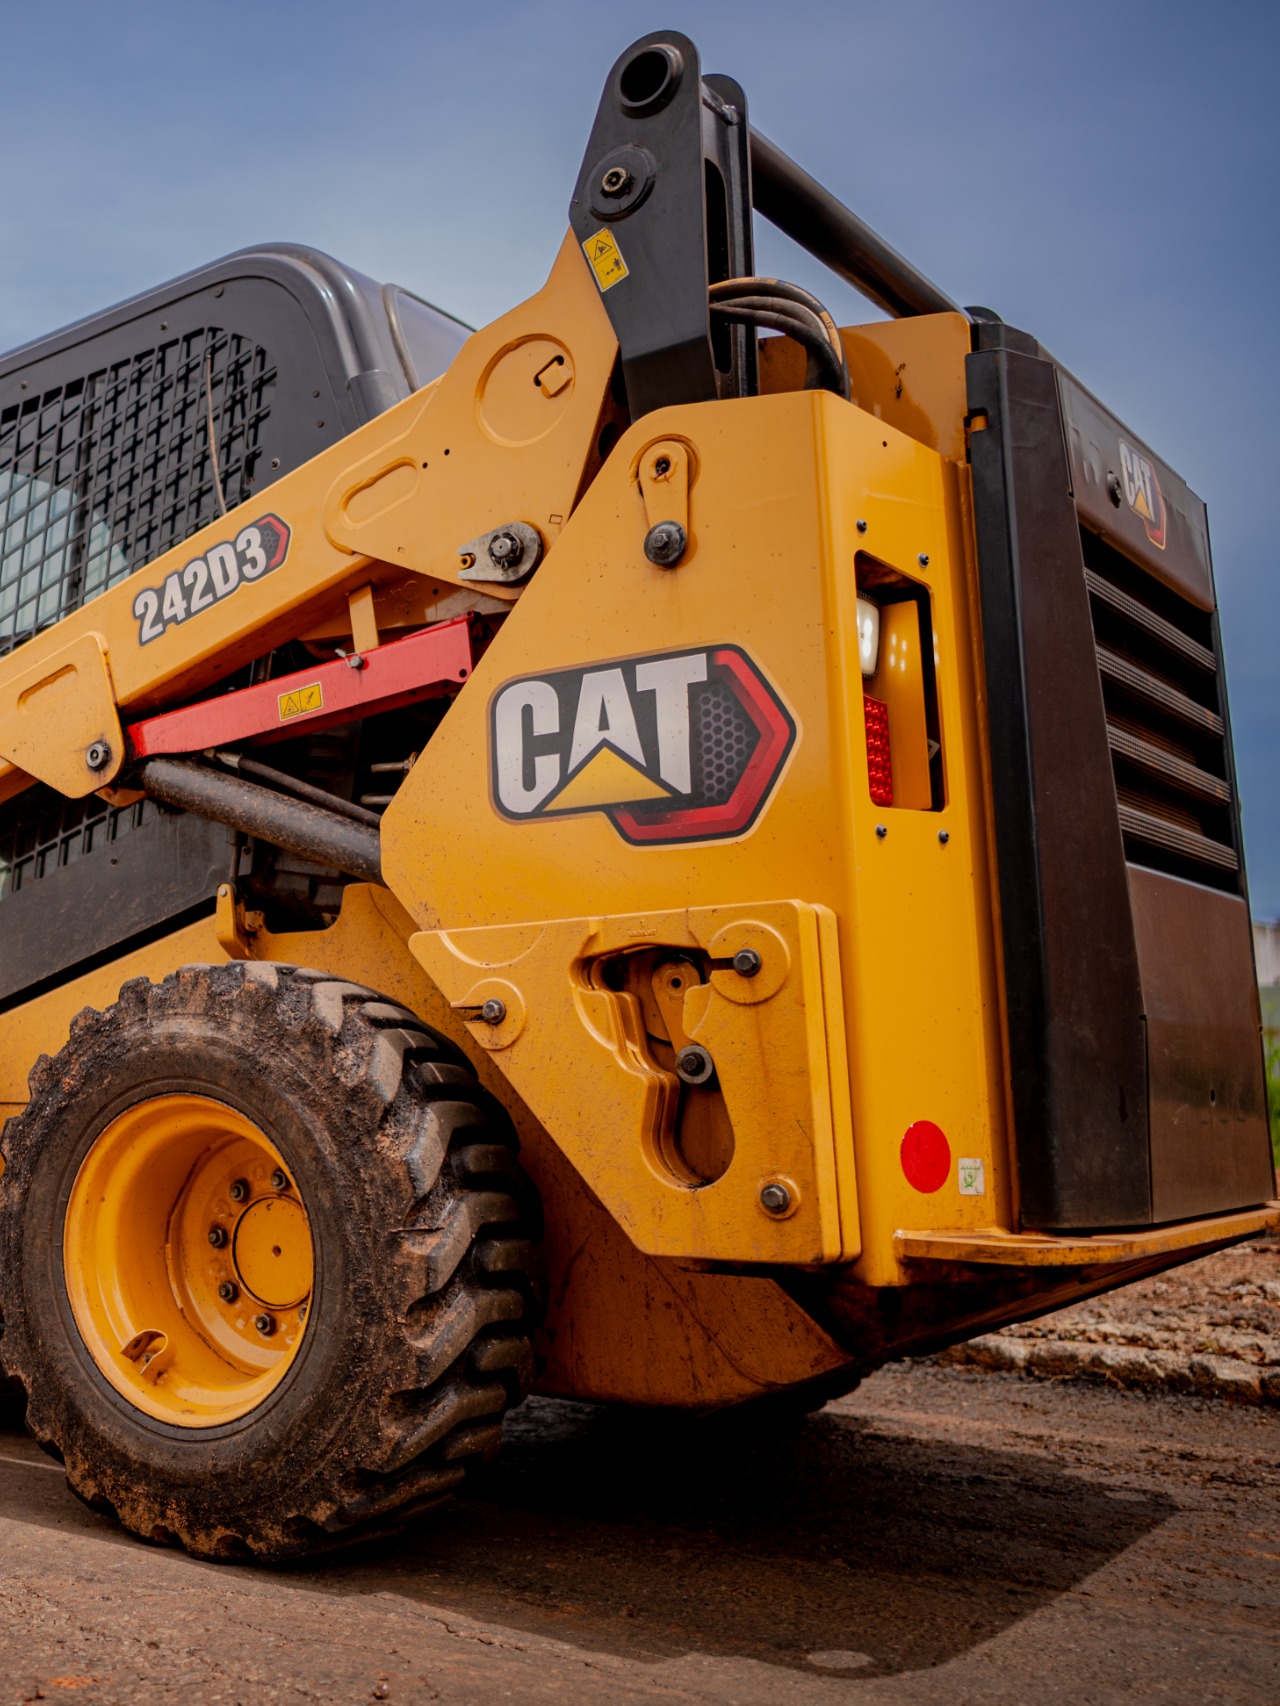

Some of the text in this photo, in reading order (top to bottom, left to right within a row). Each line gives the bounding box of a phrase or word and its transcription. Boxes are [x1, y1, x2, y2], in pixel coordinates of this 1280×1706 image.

[1120, 442, 1154, 522] CAT
[134, 526, 267, 643] 242D3
[495, 653, 708, 813] CAT
